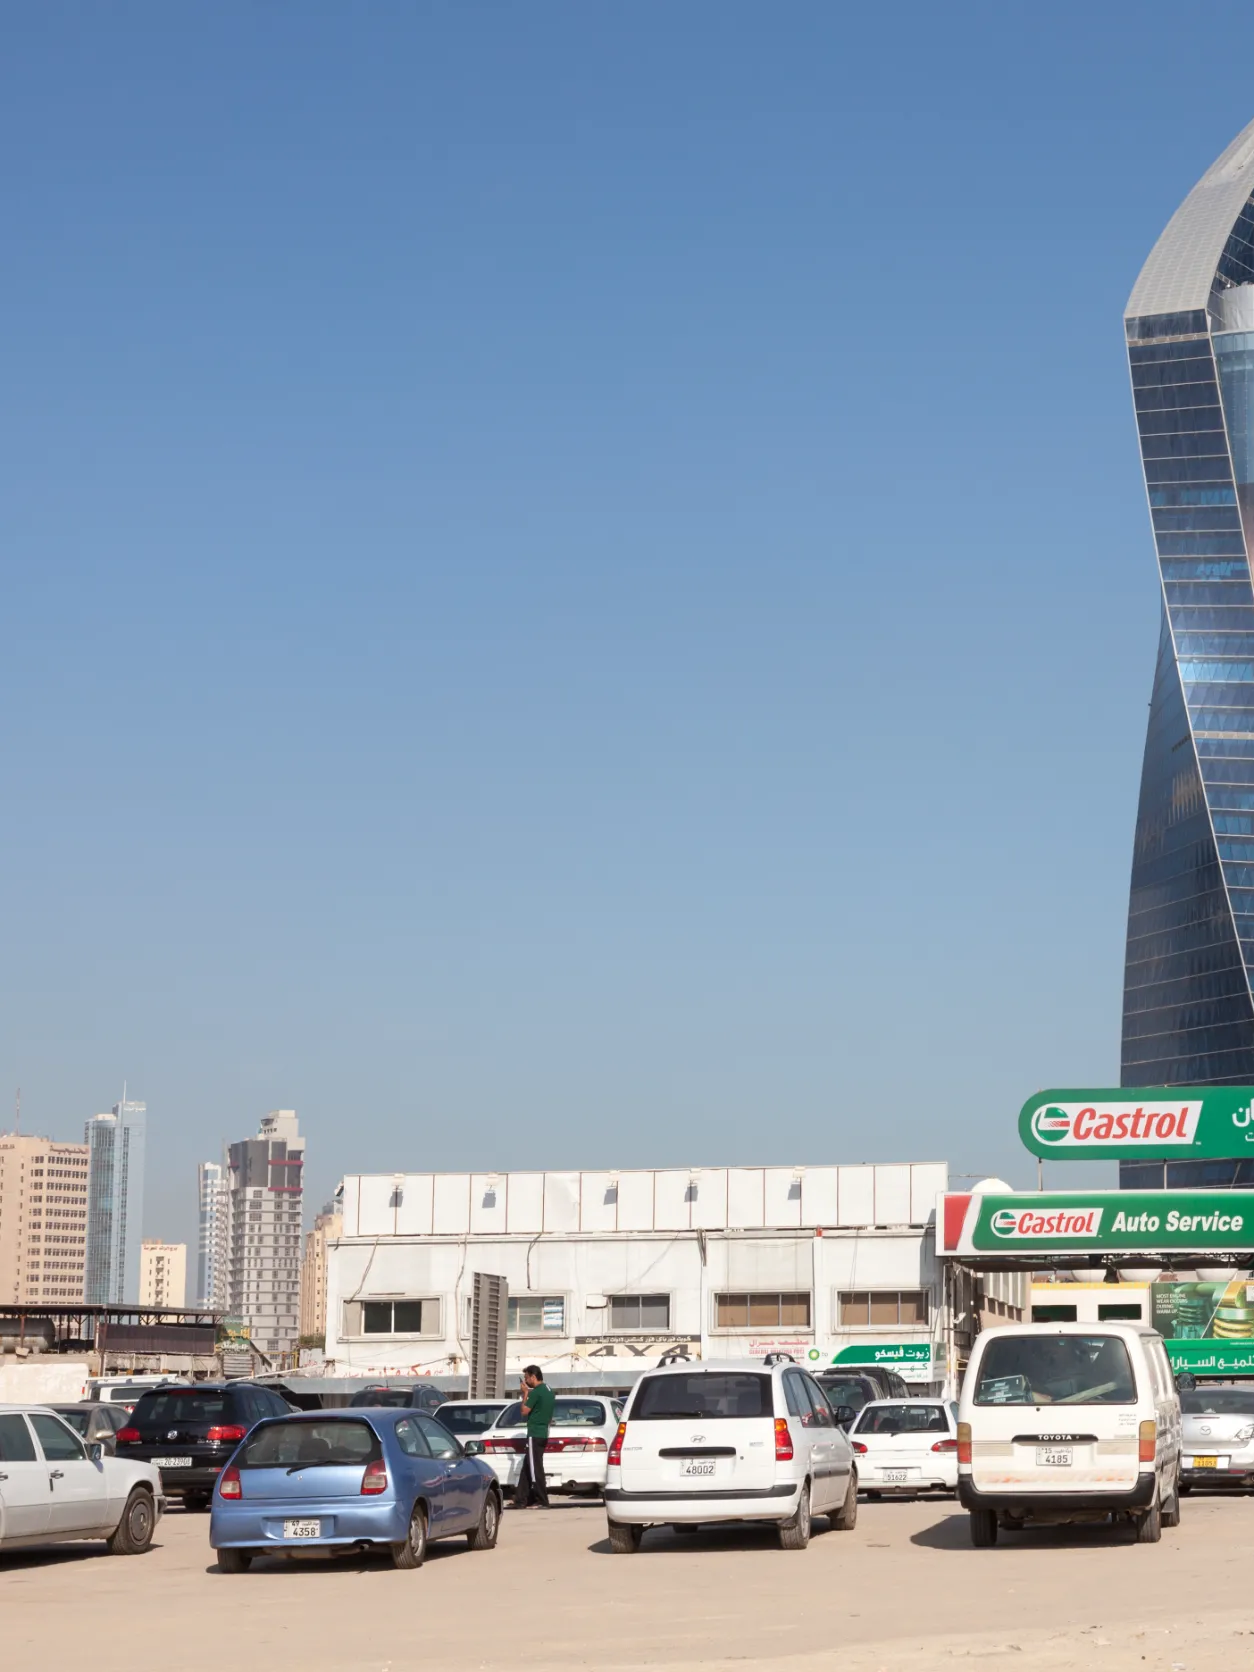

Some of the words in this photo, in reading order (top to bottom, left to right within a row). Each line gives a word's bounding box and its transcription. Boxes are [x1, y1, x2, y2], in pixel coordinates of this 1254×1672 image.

[1073, 1107, 1188, 1140] Castrol
[1018, 1212, 1094, 1234] Castrol
[1111, 1212, 1160, 1233] Auto
[1166, 1210, 1243, 1233] Service
[588, 1344, 692, 1357] 4X4
[905, 1347, 929, 1359] زيوت
[1170, 1356, 1216, 1370] السيارا
[1045, 1455, 1068, 1463] 4185
[686, 1466, 714, 1474] 48002
[293, 1527, 316, 1536] 4358
